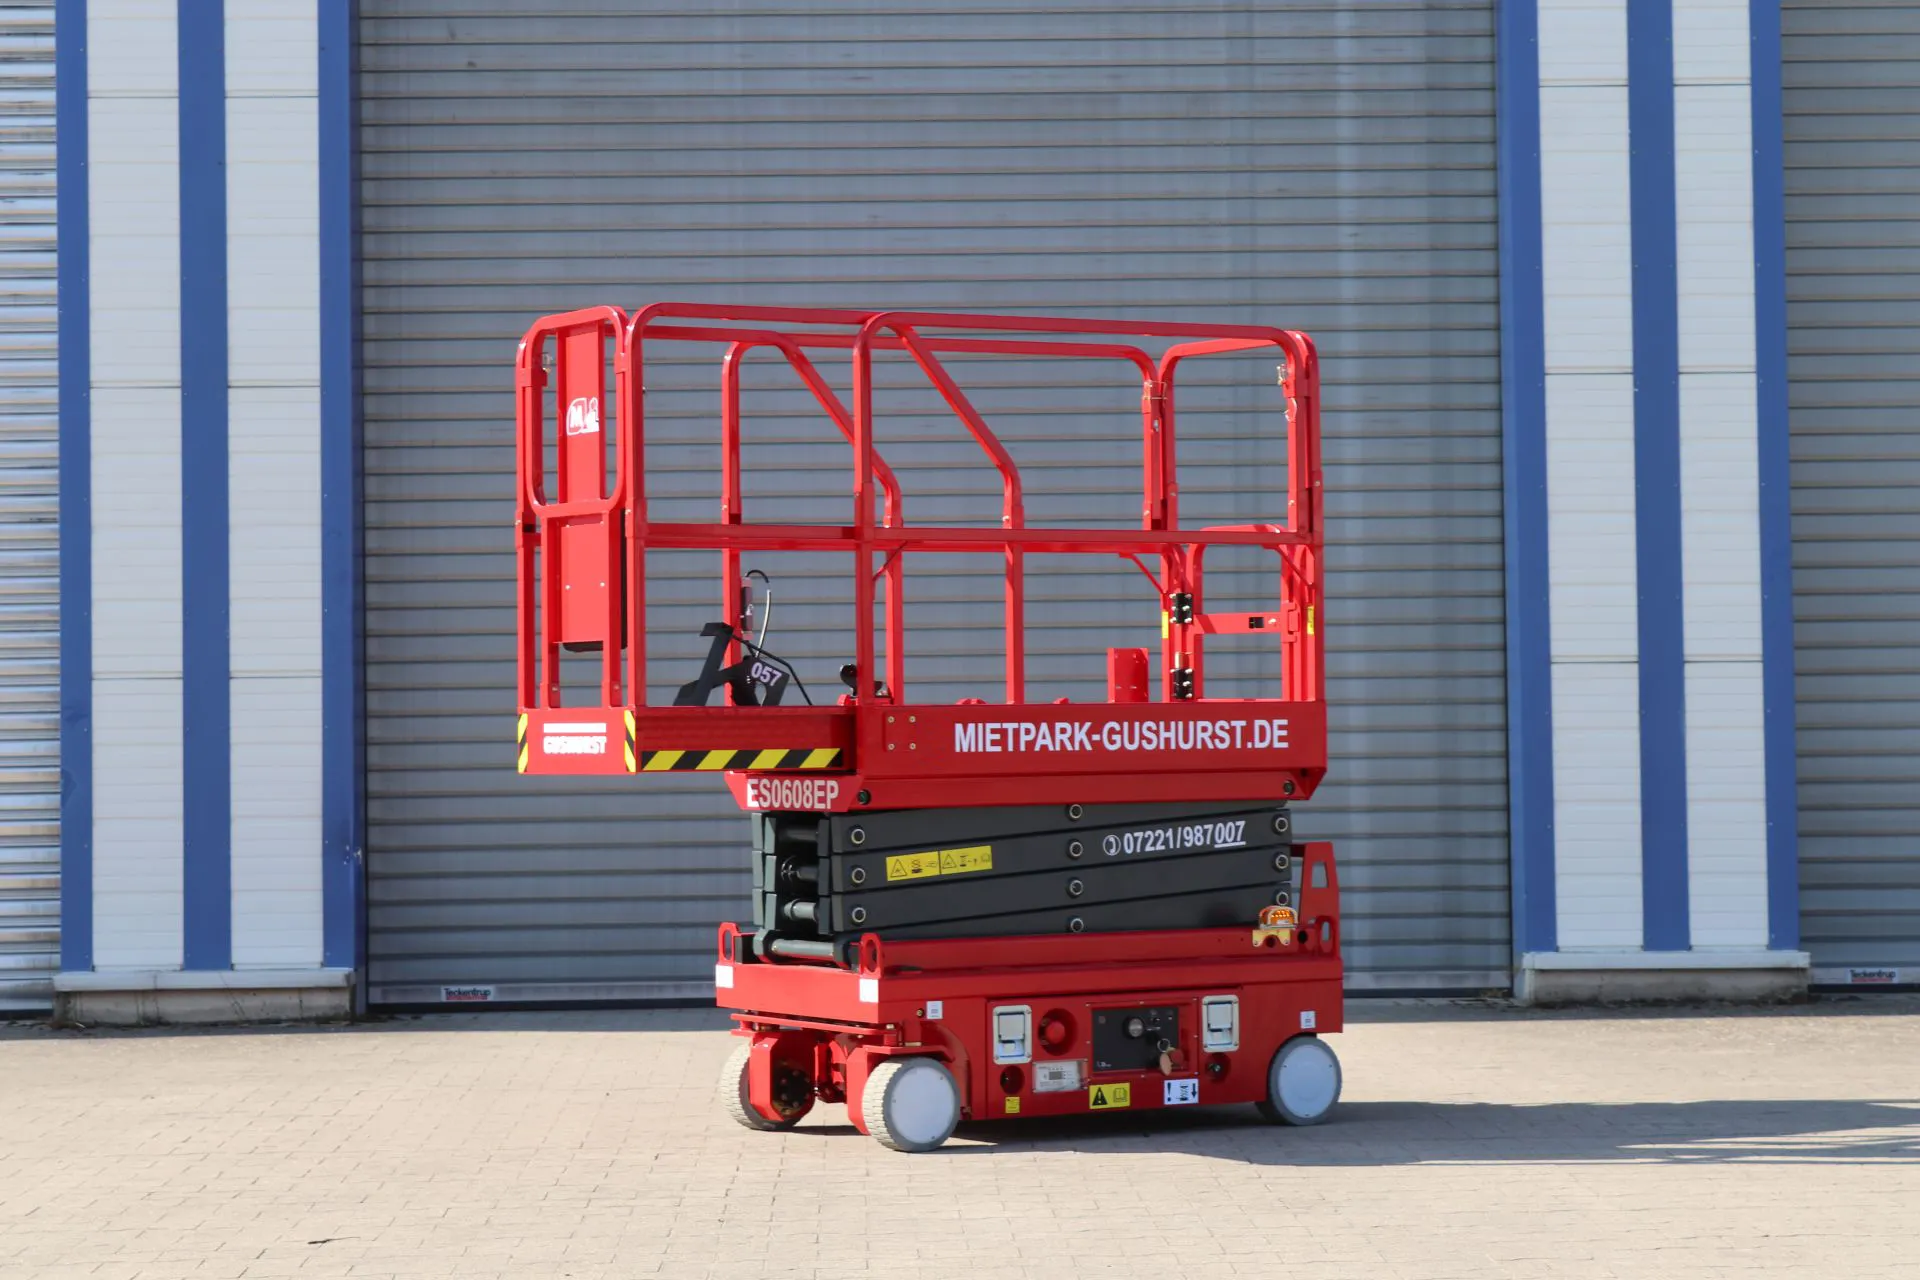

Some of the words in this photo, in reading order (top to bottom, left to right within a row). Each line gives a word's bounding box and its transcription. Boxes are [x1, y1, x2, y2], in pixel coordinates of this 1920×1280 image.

[751, 662, 782, 686] 057
[954, 719, 1289, 752] MIETPARK-GUSHURST.DE
[746, 778, 839, 810] ES0608EP
[1123, 821, 1246, 854] 07221/987007
